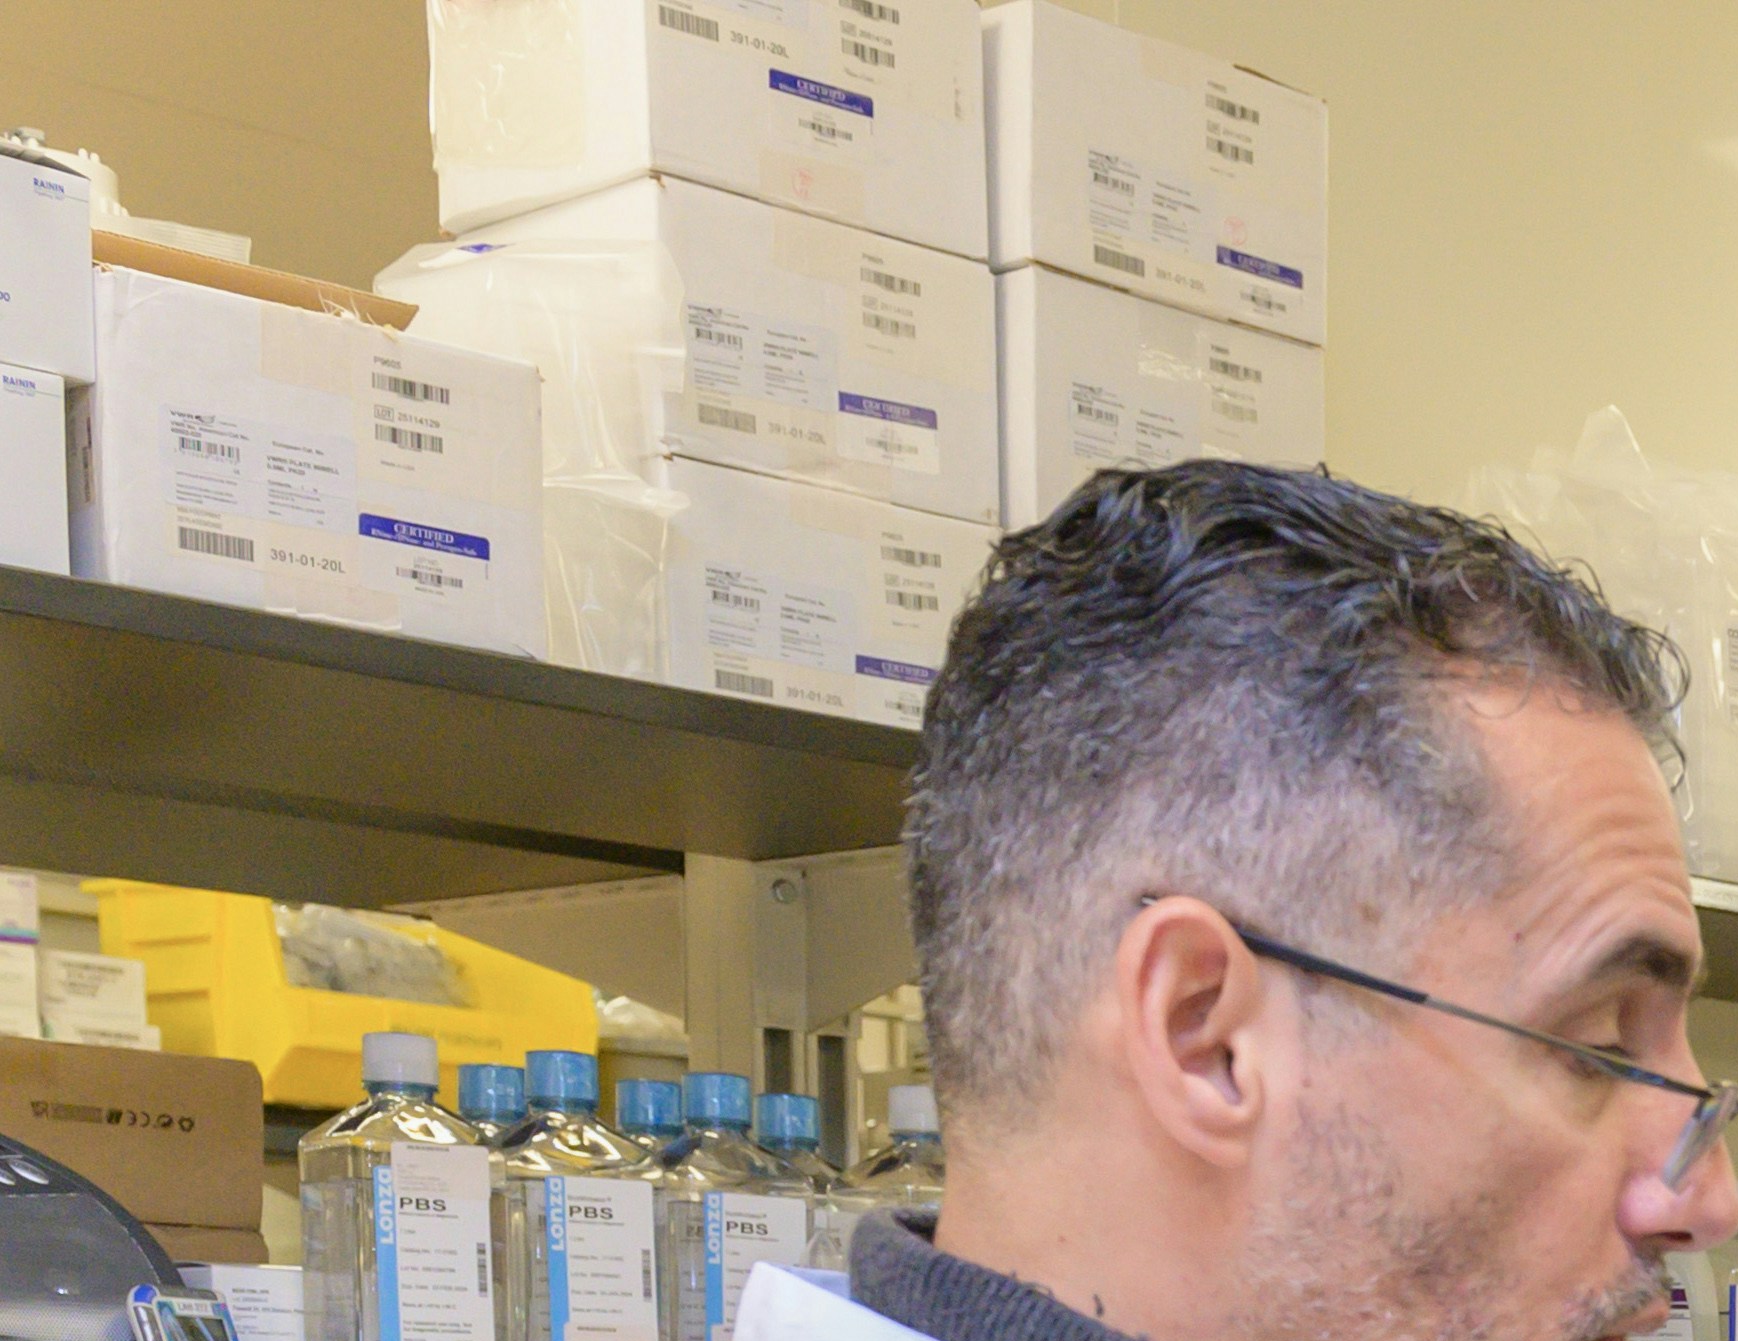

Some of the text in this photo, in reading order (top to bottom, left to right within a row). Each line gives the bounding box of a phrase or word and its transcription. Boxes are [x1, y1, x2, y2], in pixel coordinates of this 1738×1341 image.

[33, 177, 65, 194] RAININ
[2, 375, 36, 390] RAININ
[393, 522, 454, 544] CERTIFIED
[270, 548, 346, 574] 391-01-20L
[399, 1196, 447, 1213] PBS
[569, 1206, 614, 1220] PBS
[726, 1221, 769, 1236] PBS
